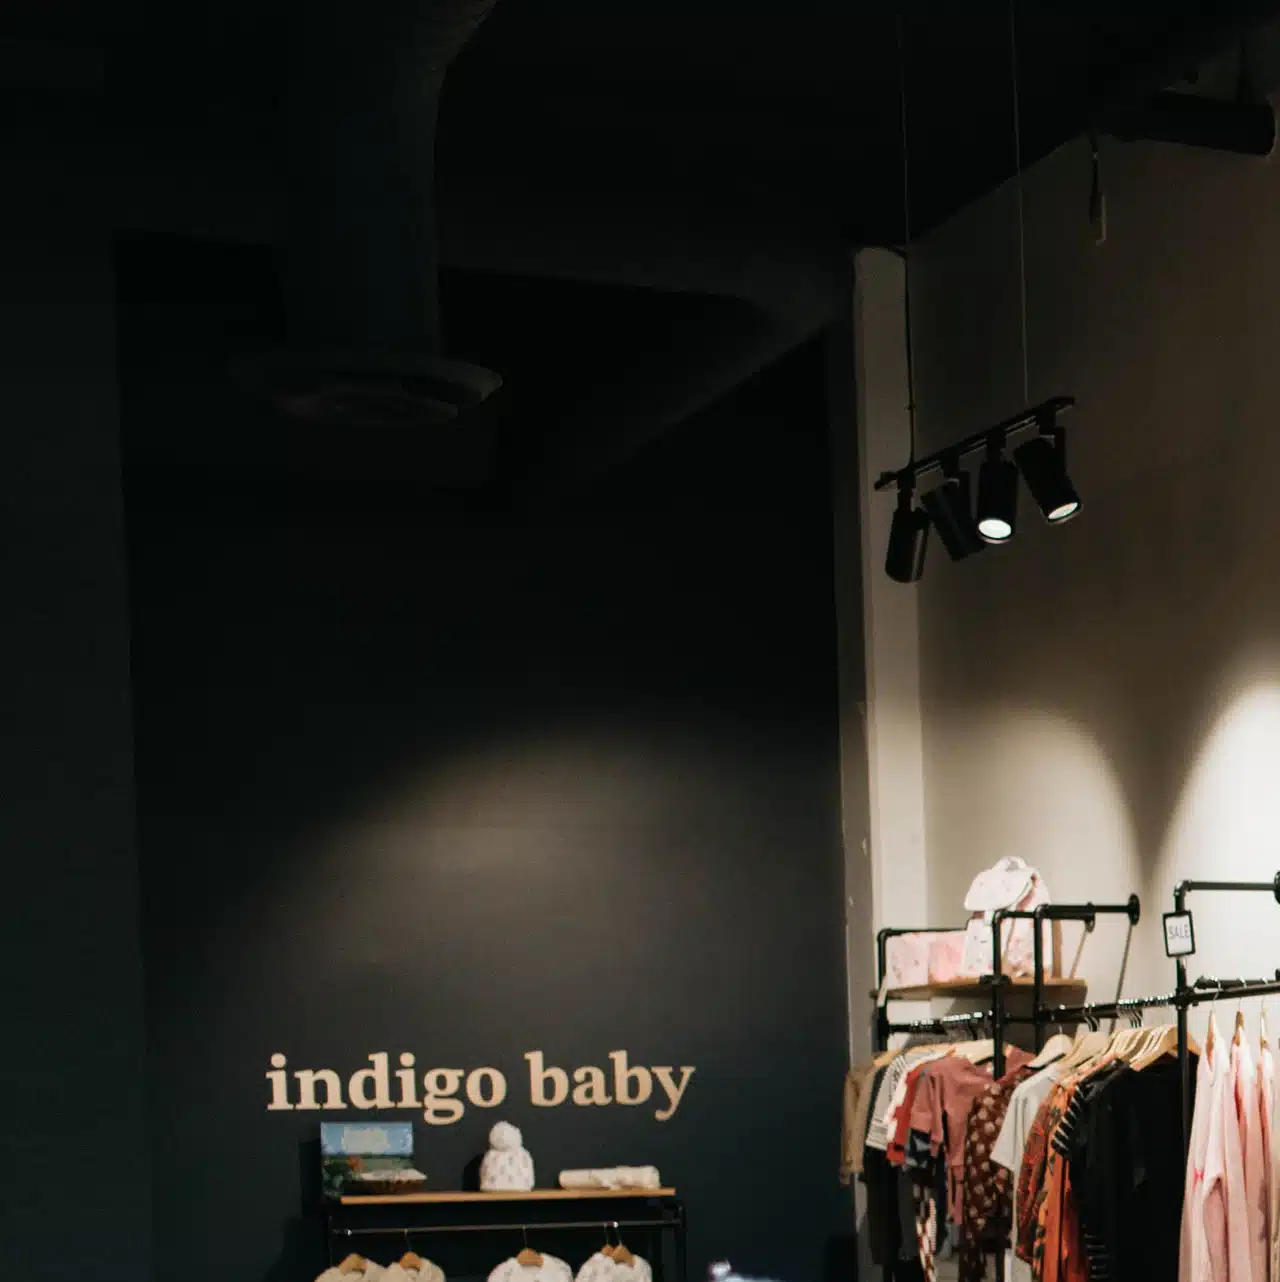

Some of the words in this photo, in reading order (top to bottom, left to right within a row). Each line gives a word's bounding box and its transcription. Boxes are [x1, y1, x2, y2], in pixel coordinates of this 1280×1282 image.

[1167, 922, 1190, 940] SALE
[264, 1051, 508, 1126] indigo
[523, 1048, 697, 1122] baby
